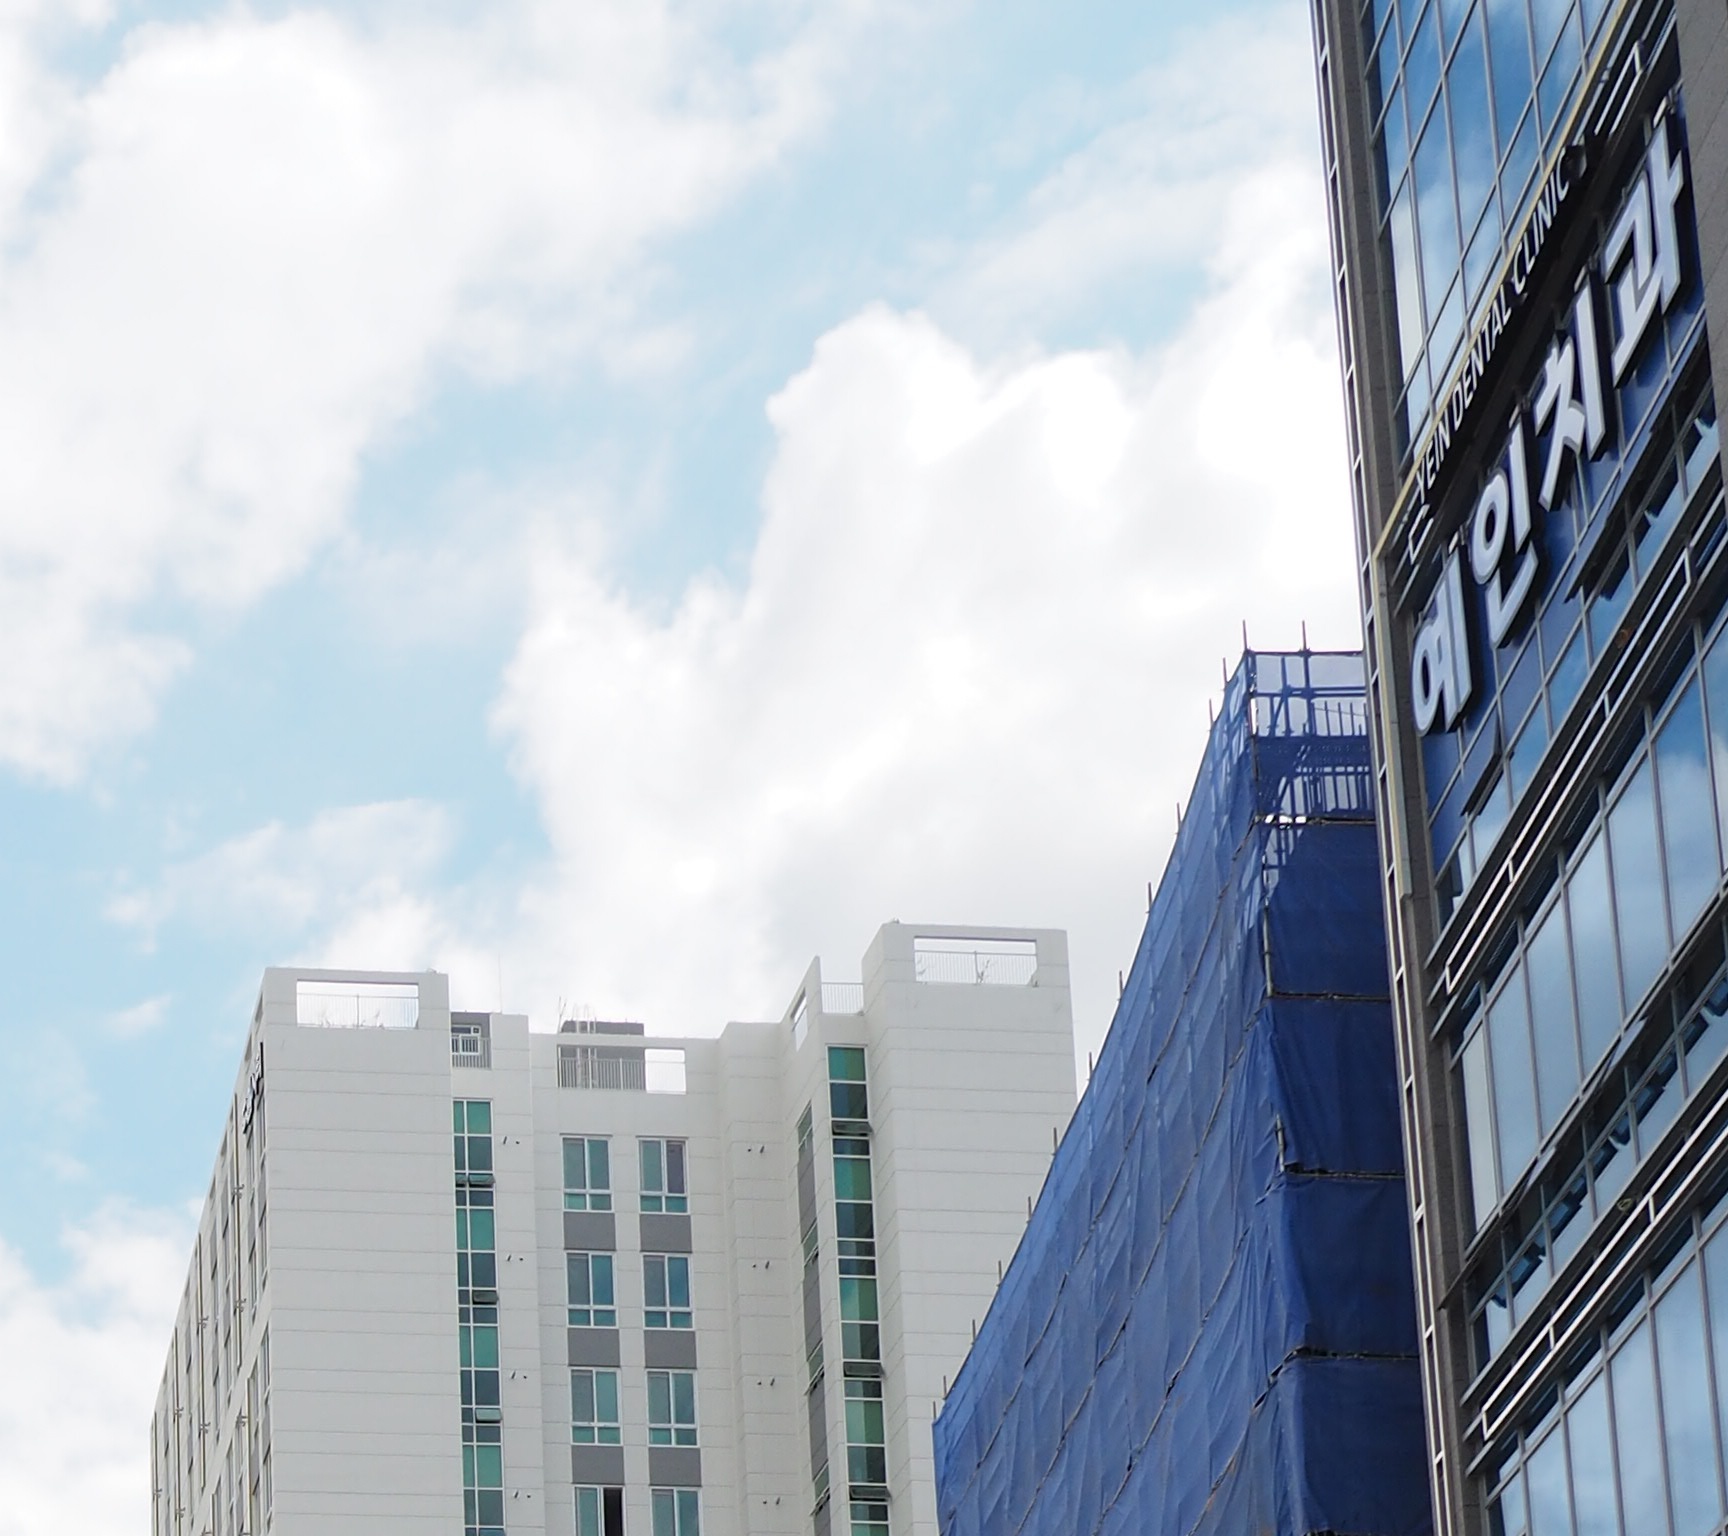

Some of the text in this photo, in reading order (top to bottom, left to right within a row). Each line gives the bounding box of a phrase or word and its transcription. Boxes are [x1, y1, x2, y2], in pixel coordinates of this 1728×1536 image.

[1411, 122, 1684, 738] 예인치과
[1416, 147, 1571, 504] YEIN DENTAL CLINIC
